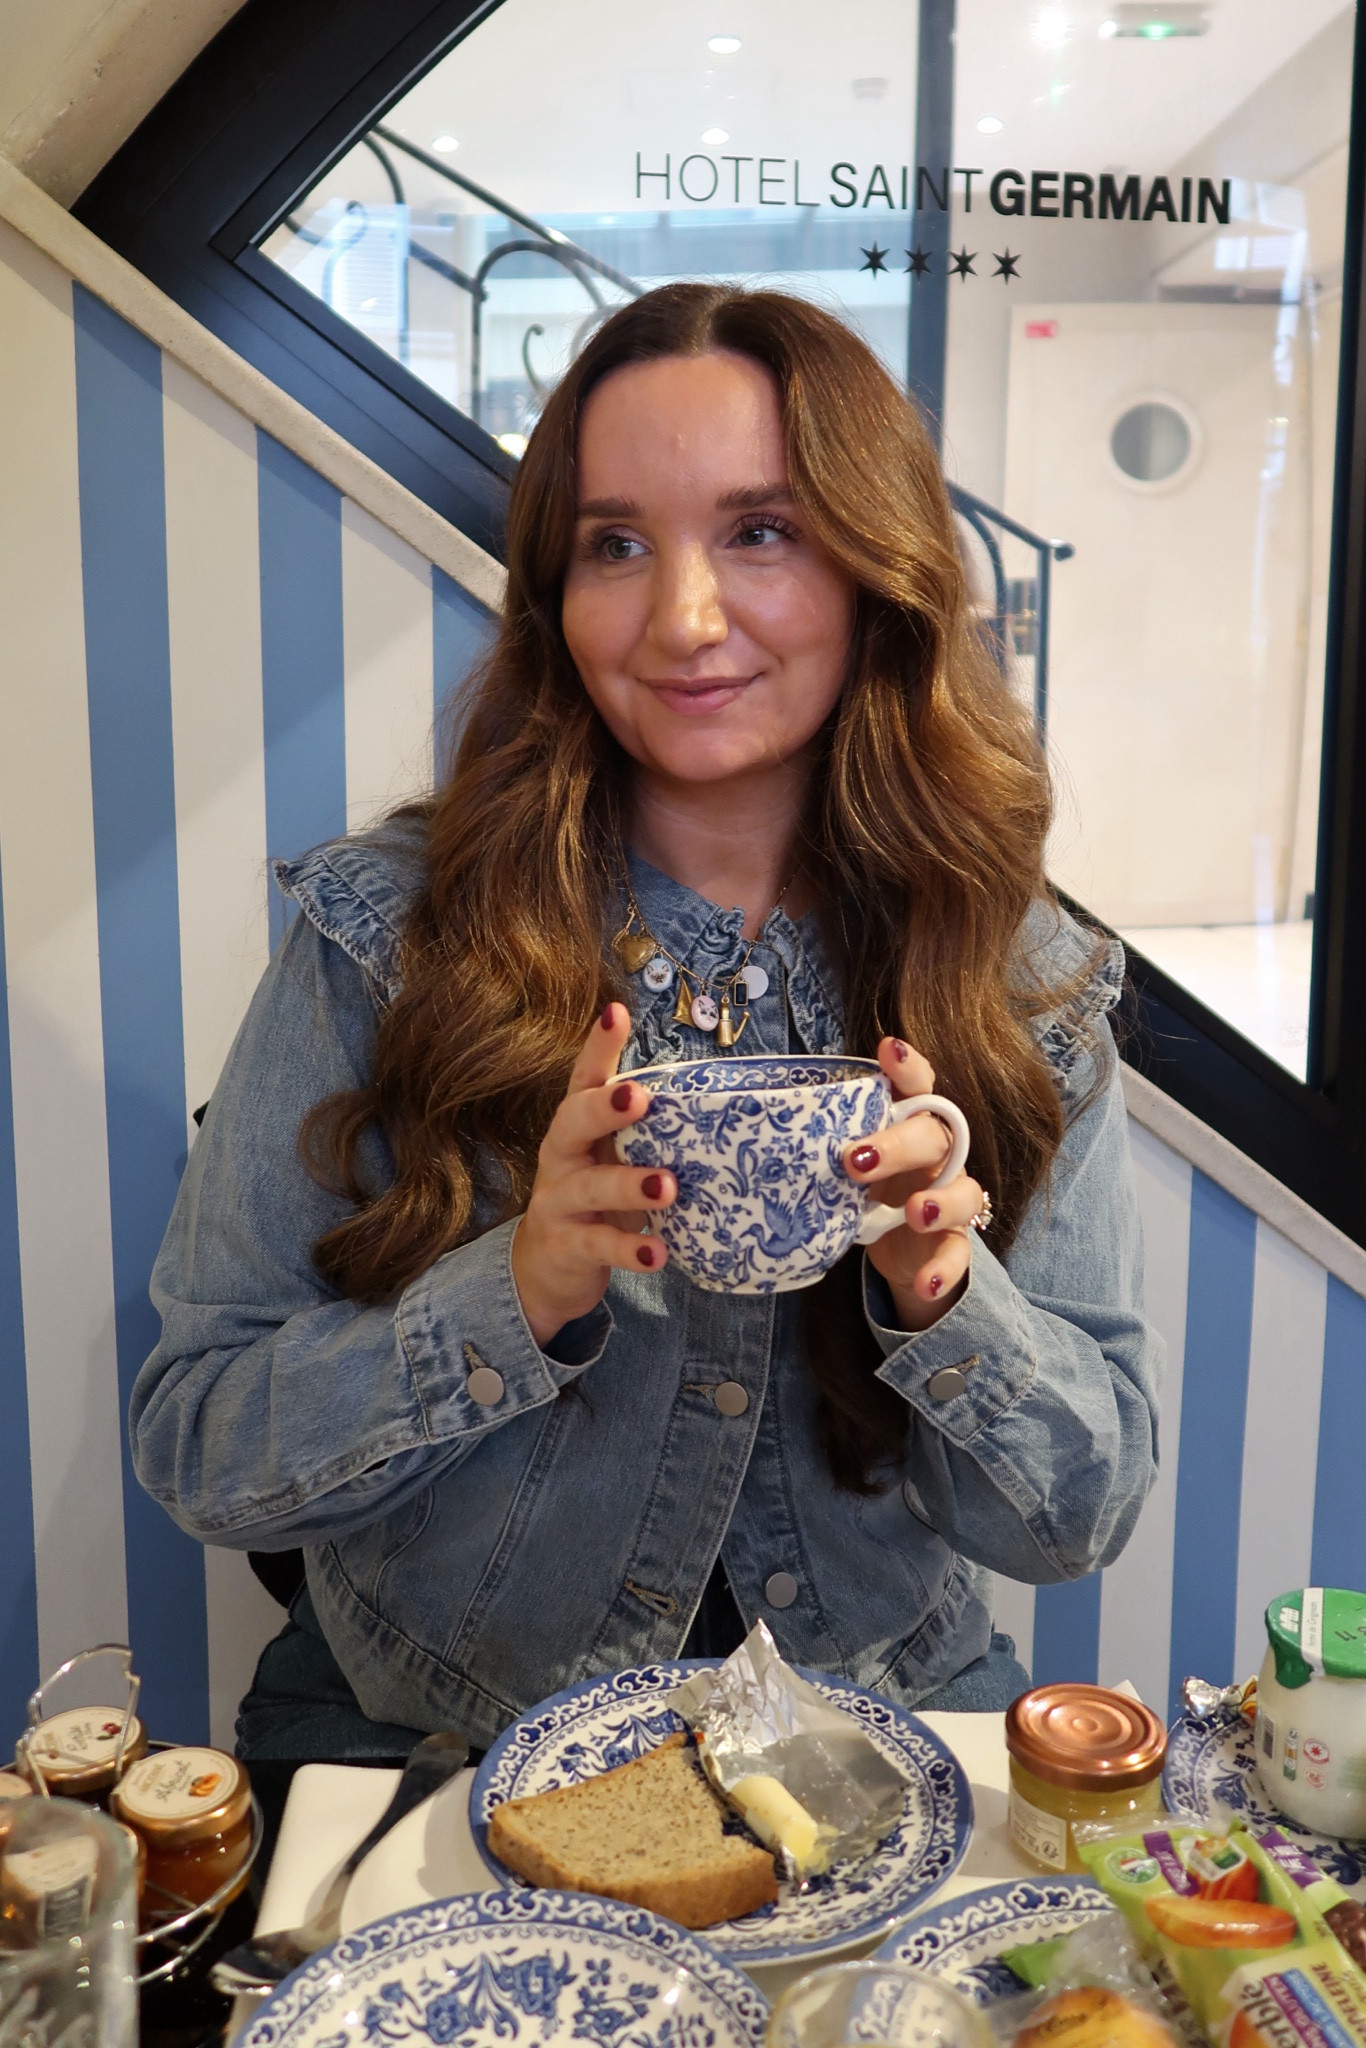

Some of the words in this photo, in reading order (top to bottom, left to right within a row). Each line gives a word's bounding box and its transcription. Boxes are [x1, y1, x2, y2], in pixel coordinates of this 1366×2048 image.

[637, 151, 821, 207] HOTEL
[829, 161, 983, 213] SAINT
[989, 168, 1231, 224] GERMAIN
